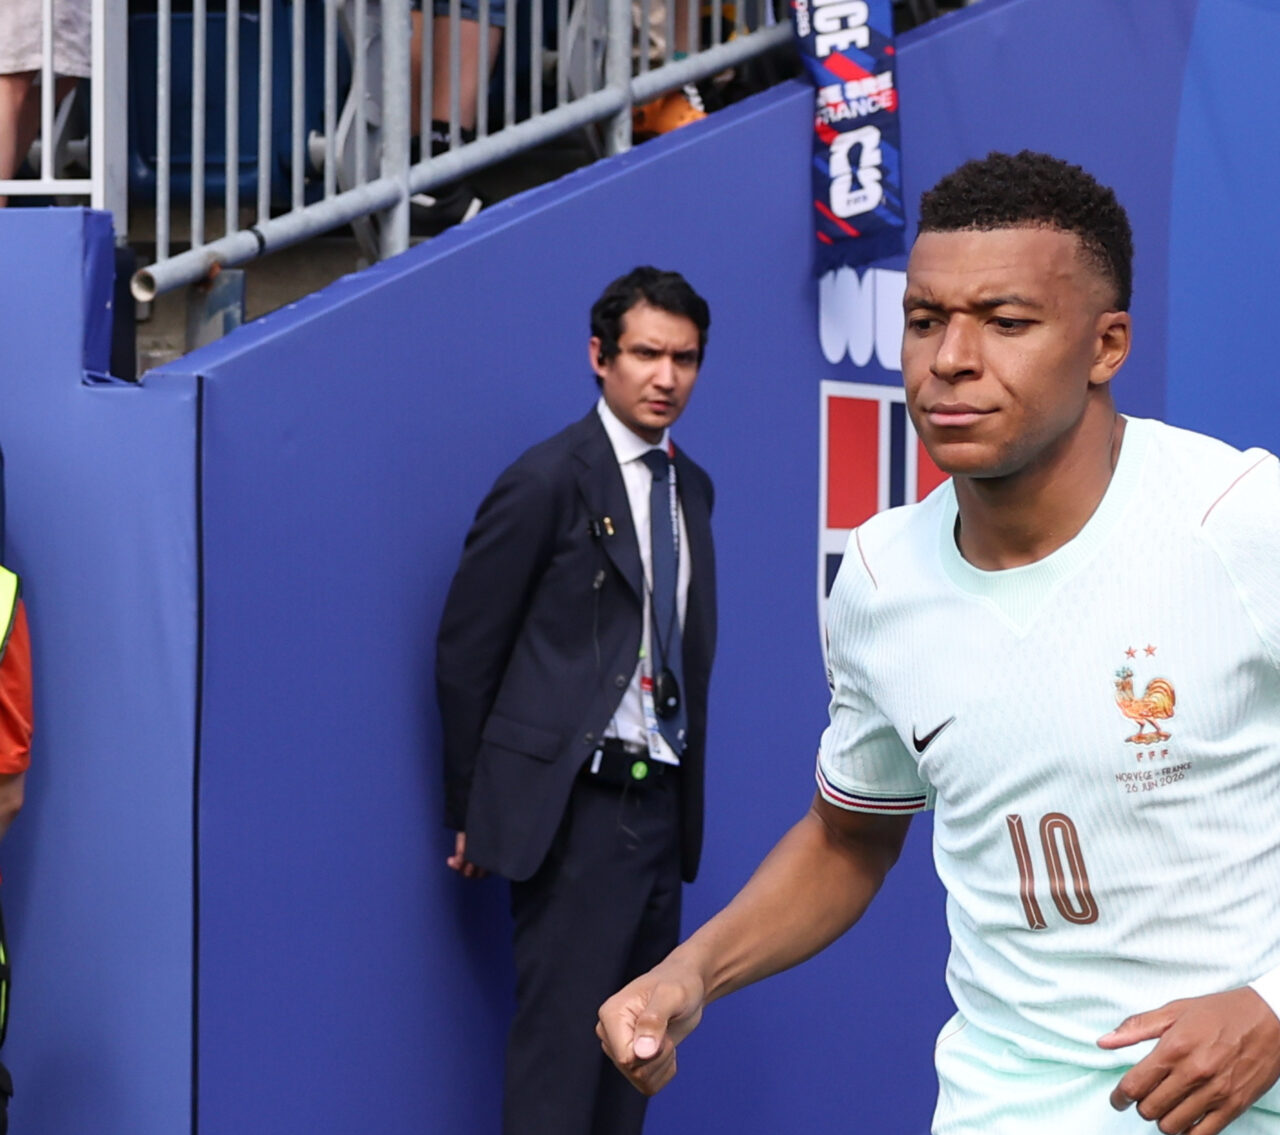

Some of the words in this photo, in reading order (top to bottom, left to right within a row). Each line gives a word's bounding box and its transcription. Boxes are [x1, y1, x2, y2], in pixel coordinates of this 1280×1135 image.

[1161, 762, 1192, 775] FRANCE
[1126, 783, 1138, 793] 26
[1160, 773, 1184, 786] 2026
[1005, 812, 1099, 930] 10
